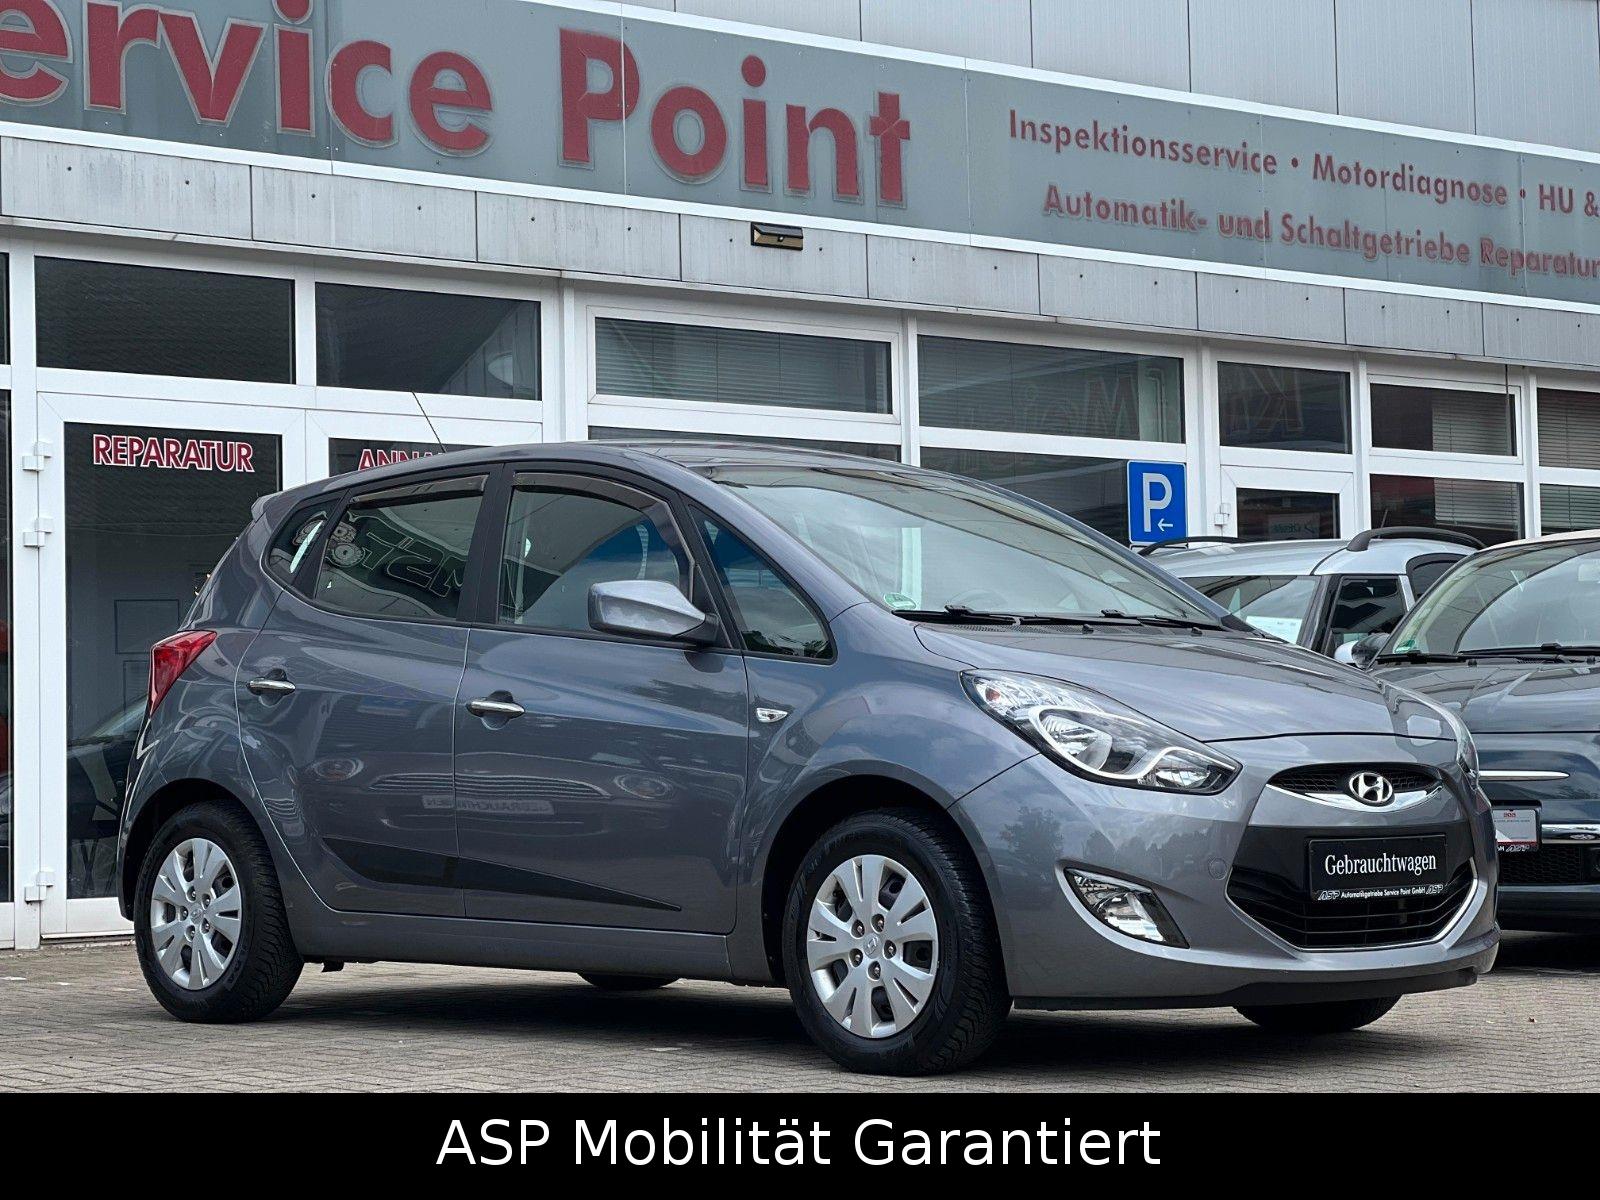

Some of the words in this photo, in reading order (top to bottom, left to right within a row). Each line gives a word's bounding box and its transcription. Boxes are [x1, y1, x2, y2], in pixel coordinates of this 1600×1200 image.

[559, 27, 911, 203] Point
[1009, 109, 1278, 175] Inspektionsservice
[1312, 152, 1508, 205] Motordiagnose
[1539, 183, 1574, 214] HU
[1043, 183, 1207, 232] Automatik-
[1218, 207, 1273, 240] und
[1280, 212, 1471, 262] Schaltgetriebe
[93, 434, 255, 472] REPARATUR
[1142, 472, 1173, 533] P
[1318, 890, 1340, 900] ASP
[1384, 889, 1400, 897] Service
[1400, 887, 1411, 895] Point
[1411, 886, 1426, 895] GmbH
[1325, 853, 1437, 876] Gebrauchtwagen
